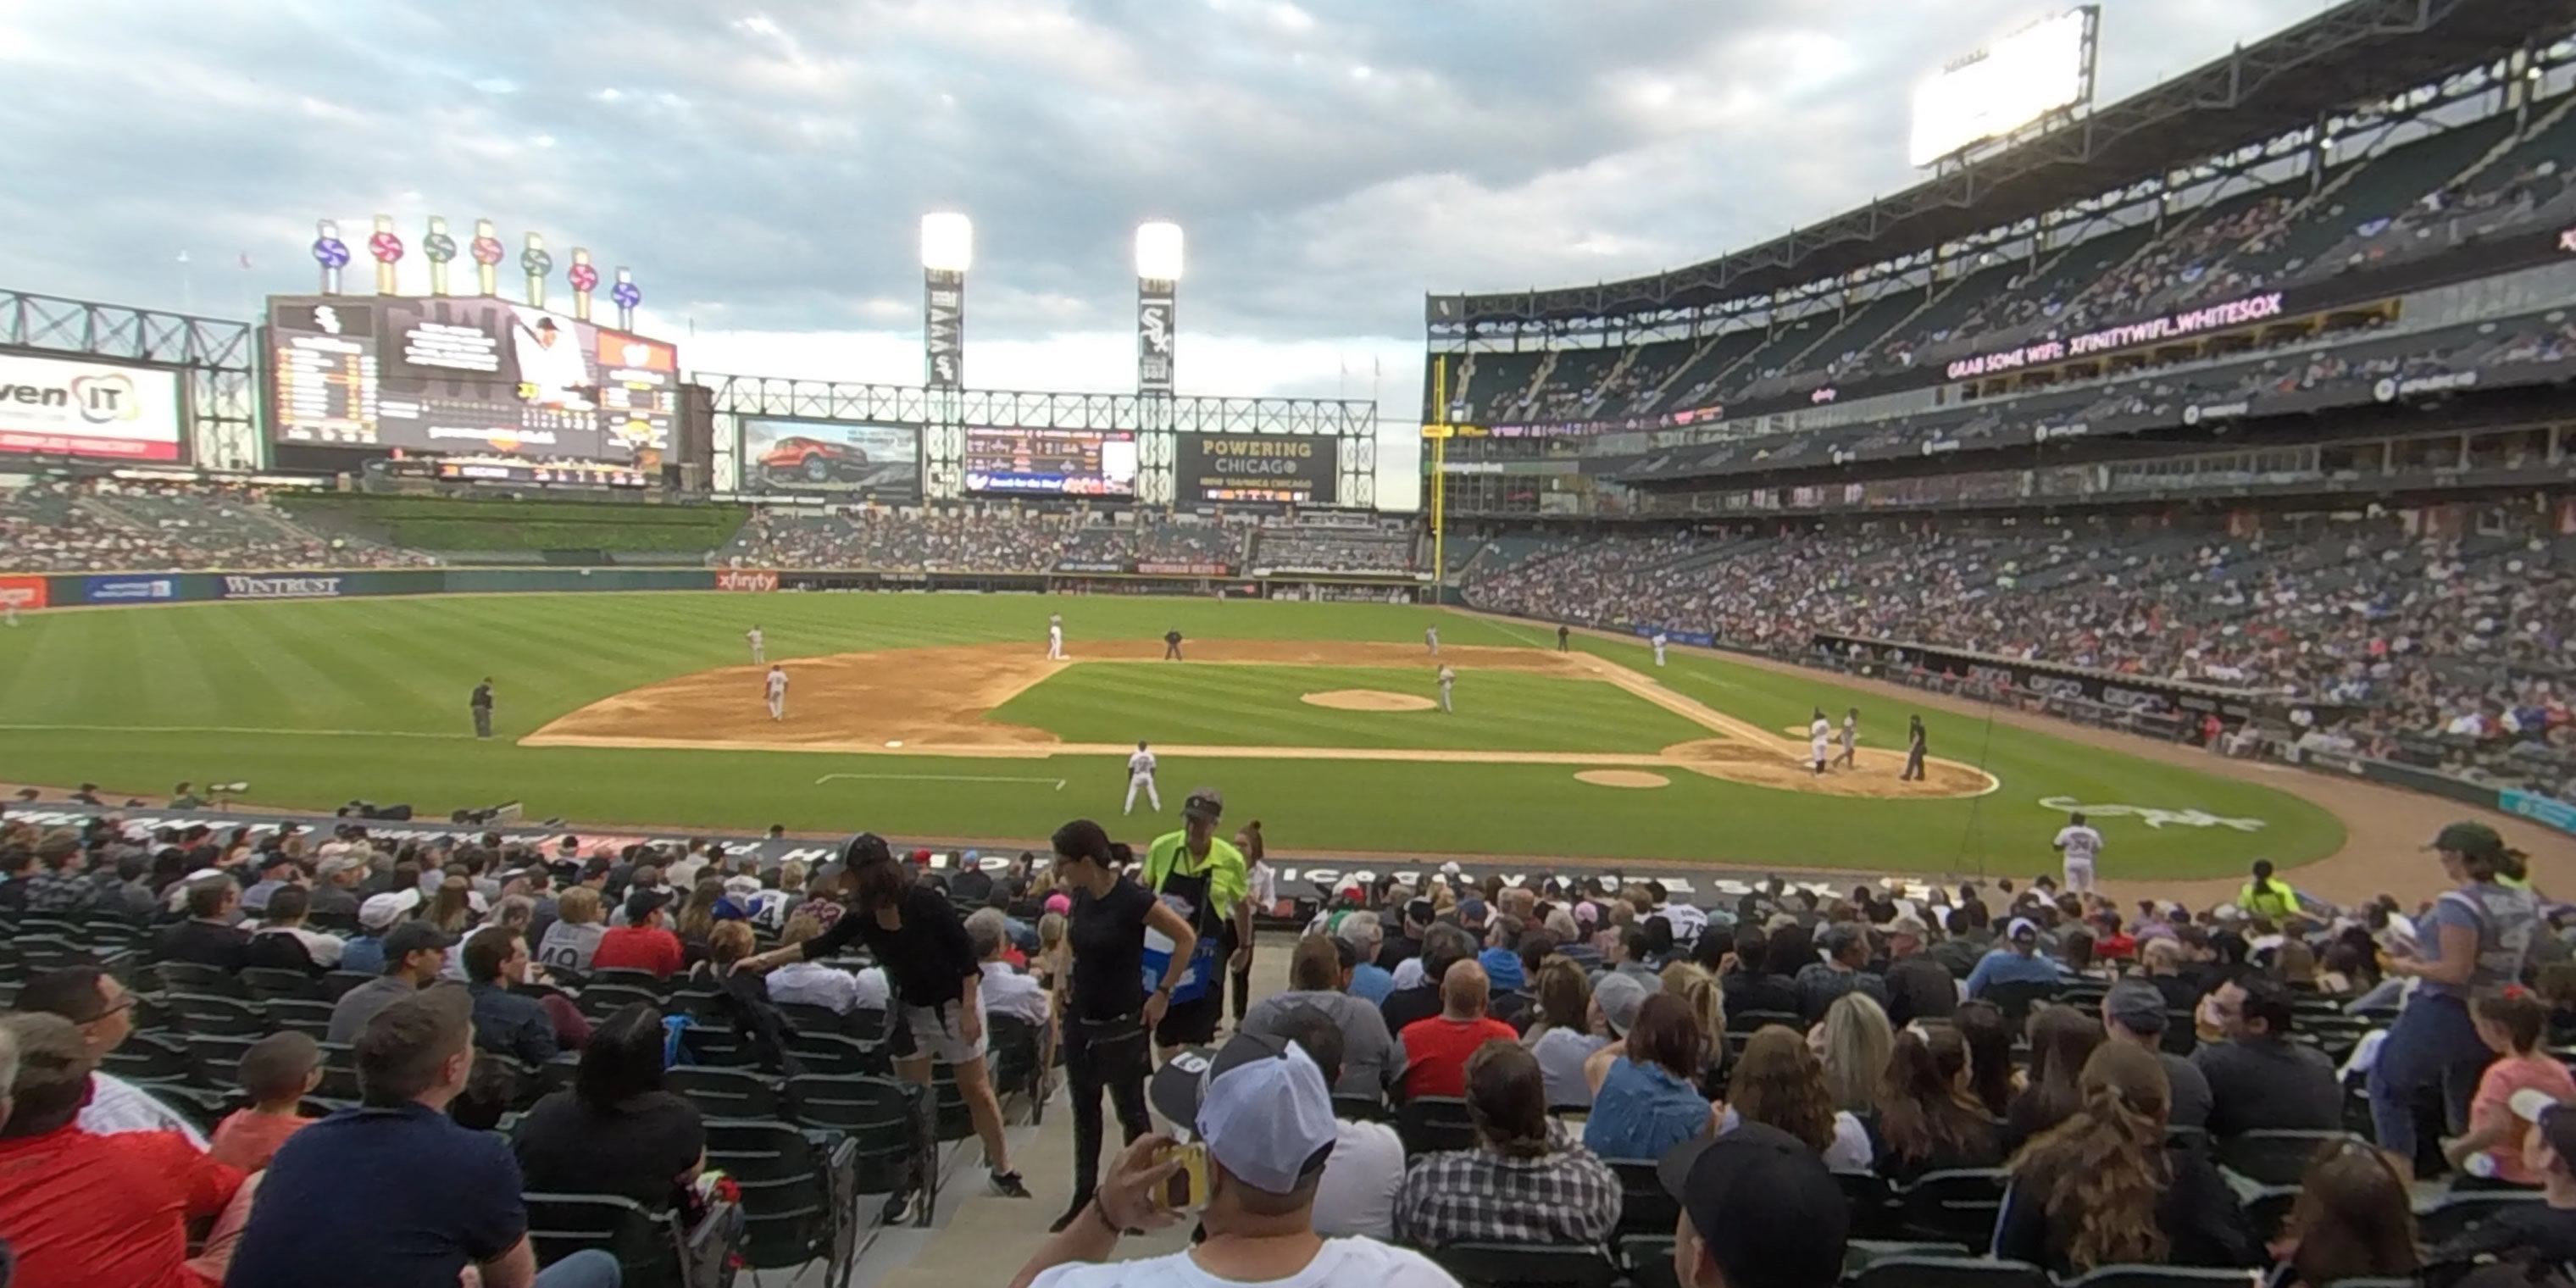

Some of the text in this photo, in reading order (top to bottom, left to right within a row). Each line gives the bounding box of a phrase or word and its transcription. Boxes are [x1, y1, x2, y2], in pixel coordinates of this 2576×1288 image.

[1947, 357, 1985, 379] GRAB
[1986, 348, 2024, 371] SOME
[89, 386, 123, 410] IT
[1202, 439, 1313, 458] POWERING
[1214, 458, 1297, 475] CHICAGO
[224, 575, 341, 595] WINTRUST
[719, 571, 777, 592] xfinity
